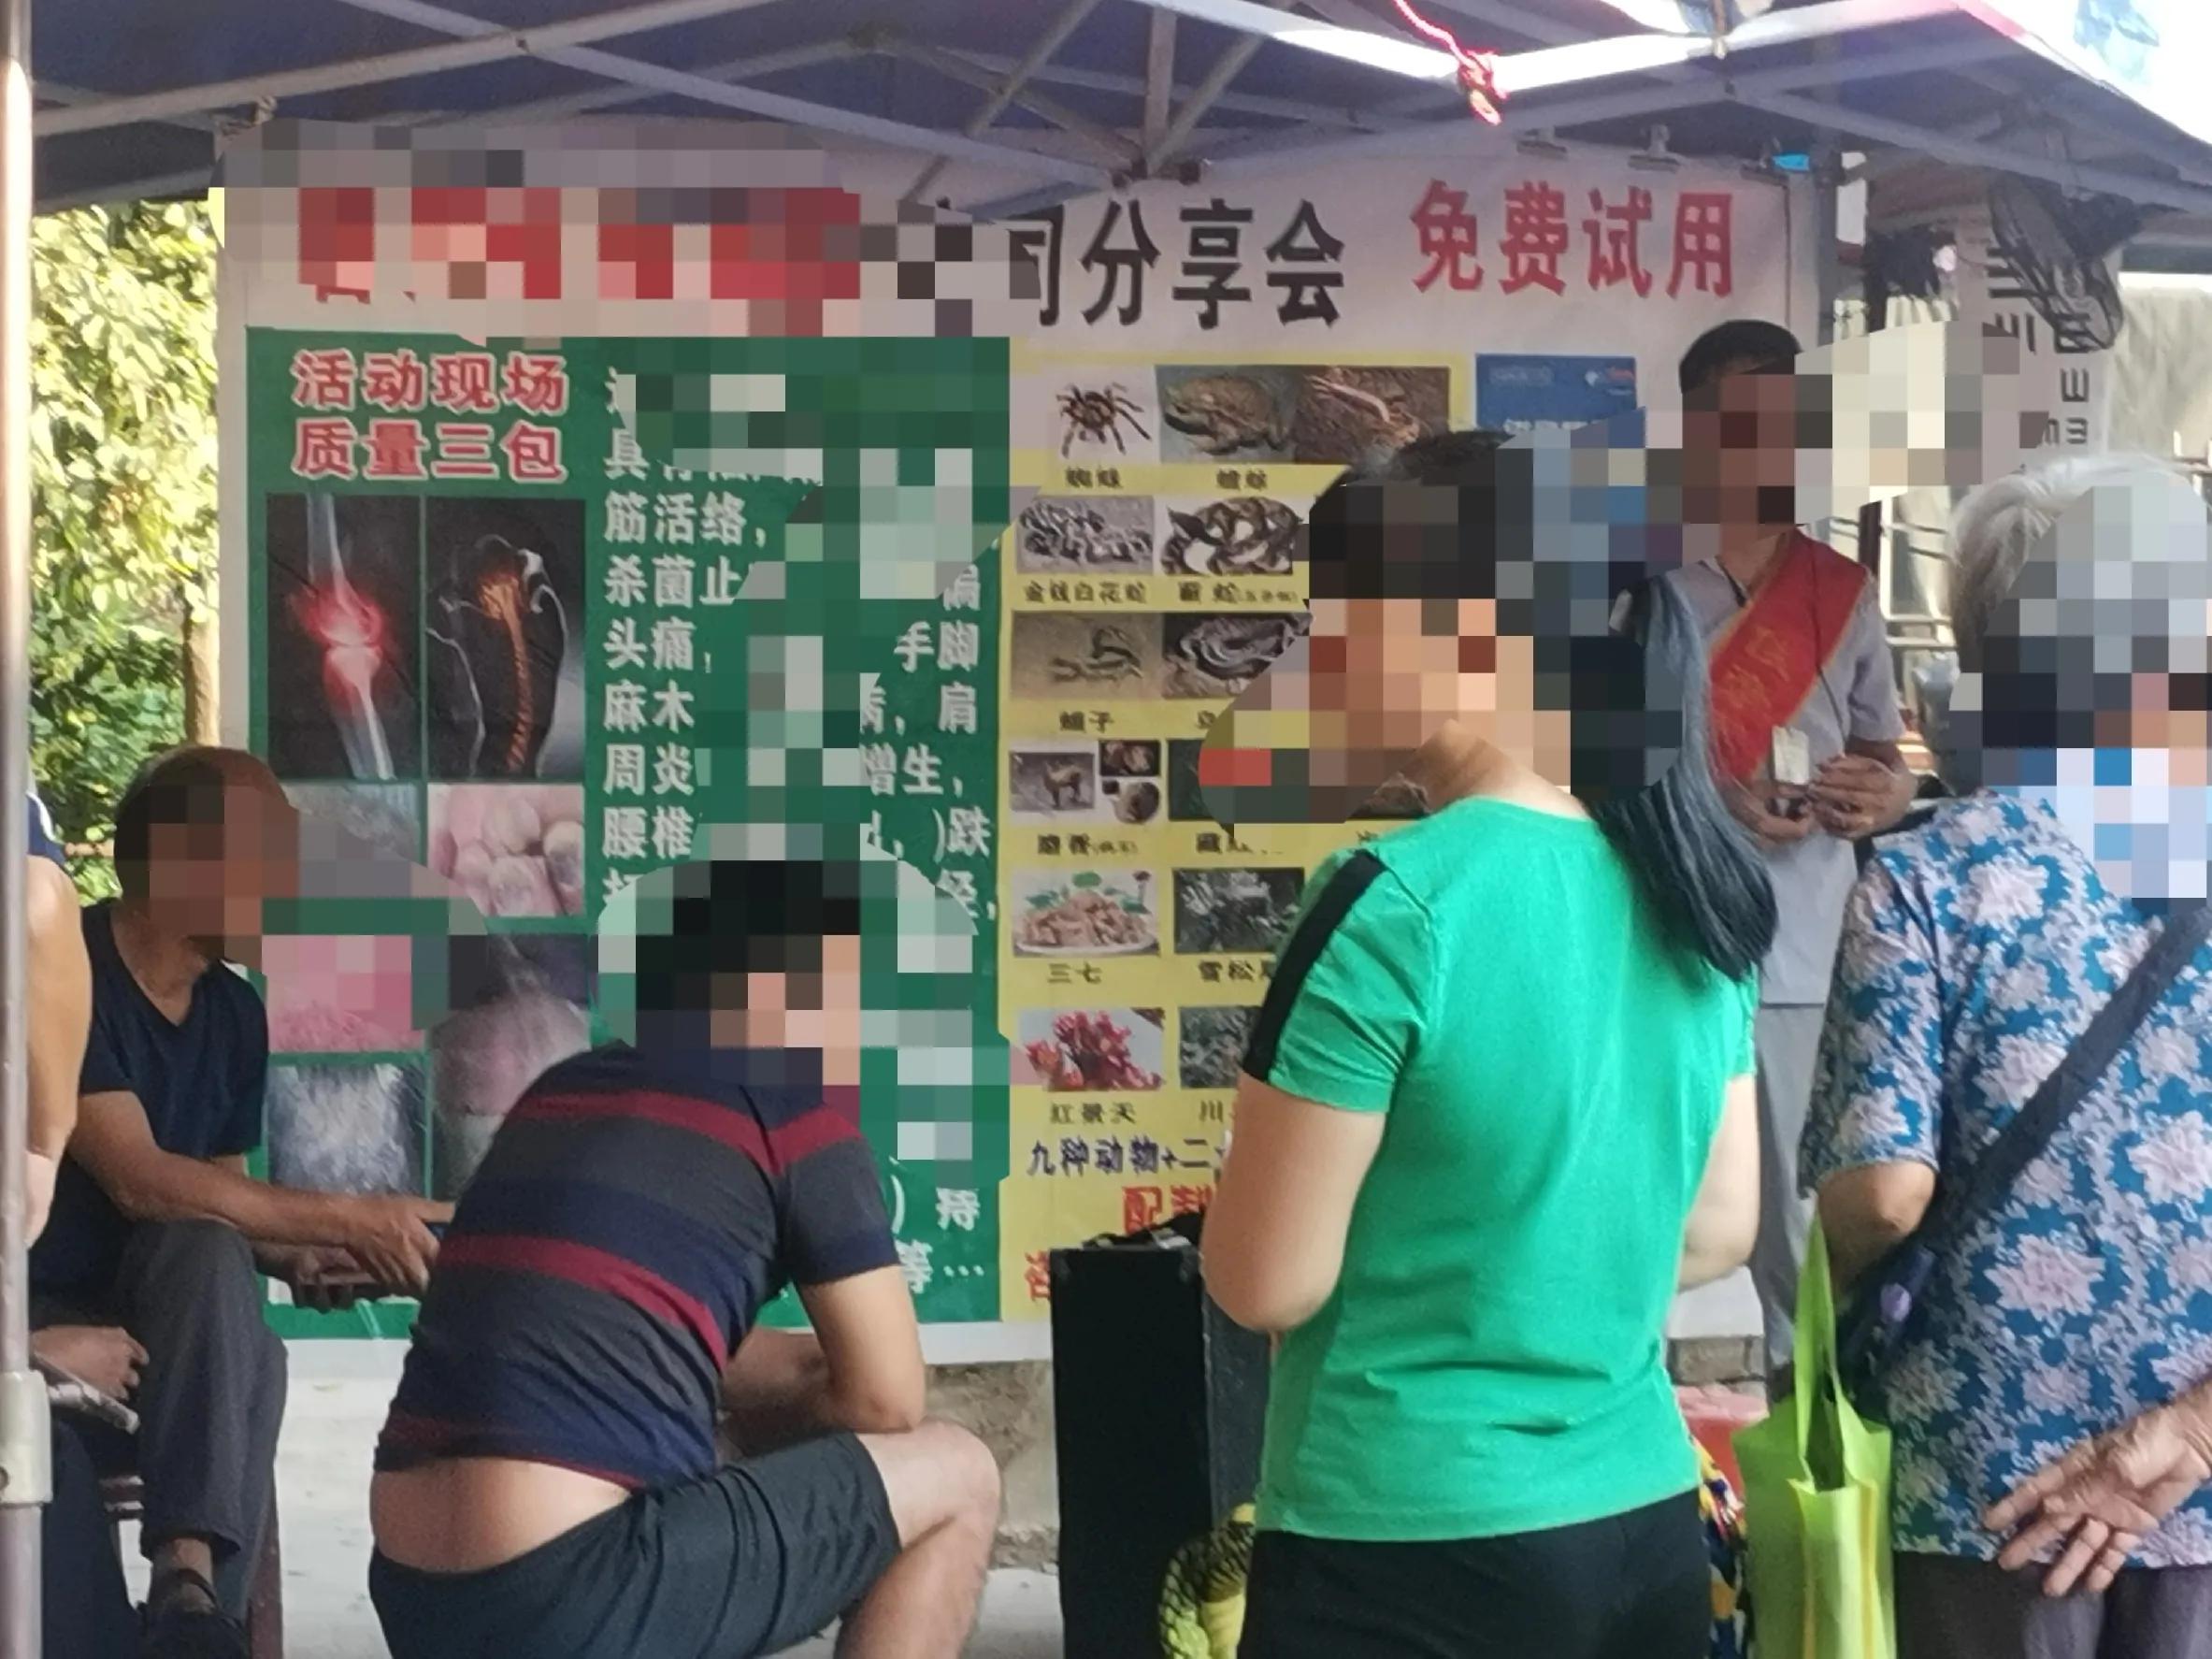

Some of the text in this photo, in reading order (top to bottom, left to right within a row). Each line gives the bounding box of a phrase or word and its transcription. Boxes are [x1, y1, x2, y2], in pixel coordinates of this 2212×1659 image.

[1409, 178, 1733, 299] 免费试用
[290, 347, 569, 417] 活动现场
[291, 416, 568, 483] 质量三包
[603, 679, 696, 733] 麻木
[603, 743, 696, 796] 周炎
[602, 806, 693, 860] 腰椎
[1047, 962, 1102, 984] 三七
